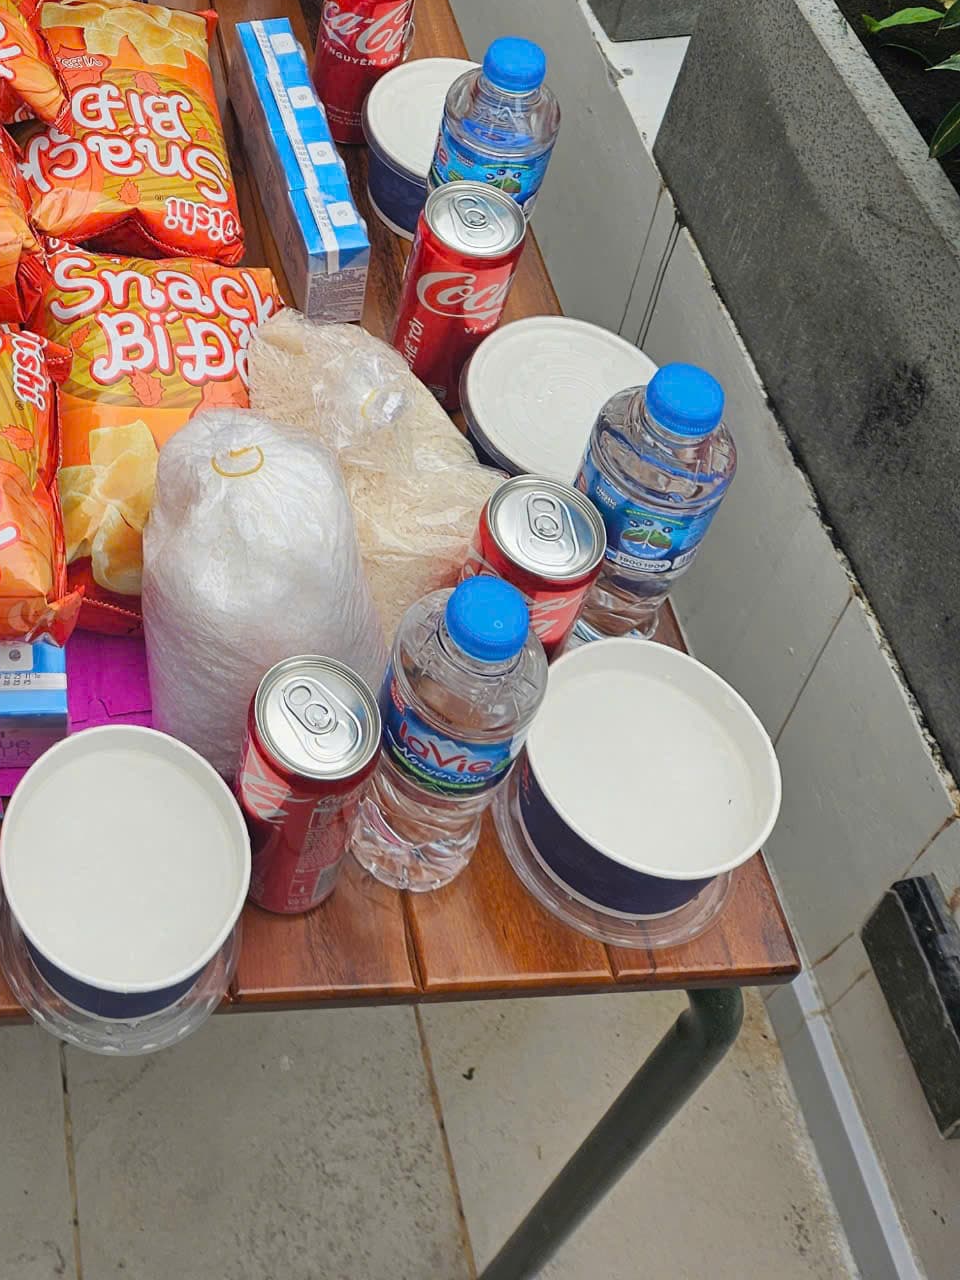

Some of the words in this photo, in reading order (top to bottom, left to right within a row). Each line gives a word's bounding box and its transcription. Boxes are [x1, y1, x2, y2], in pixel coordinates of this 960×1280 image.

[120, 93, 192, 142] Bí
[17, 133, 230, 204] Snack
[164, 196, 240, 245] Oishi
[49, 256, 274, 321] Snack
[91, 310, 180, 383] Bí
